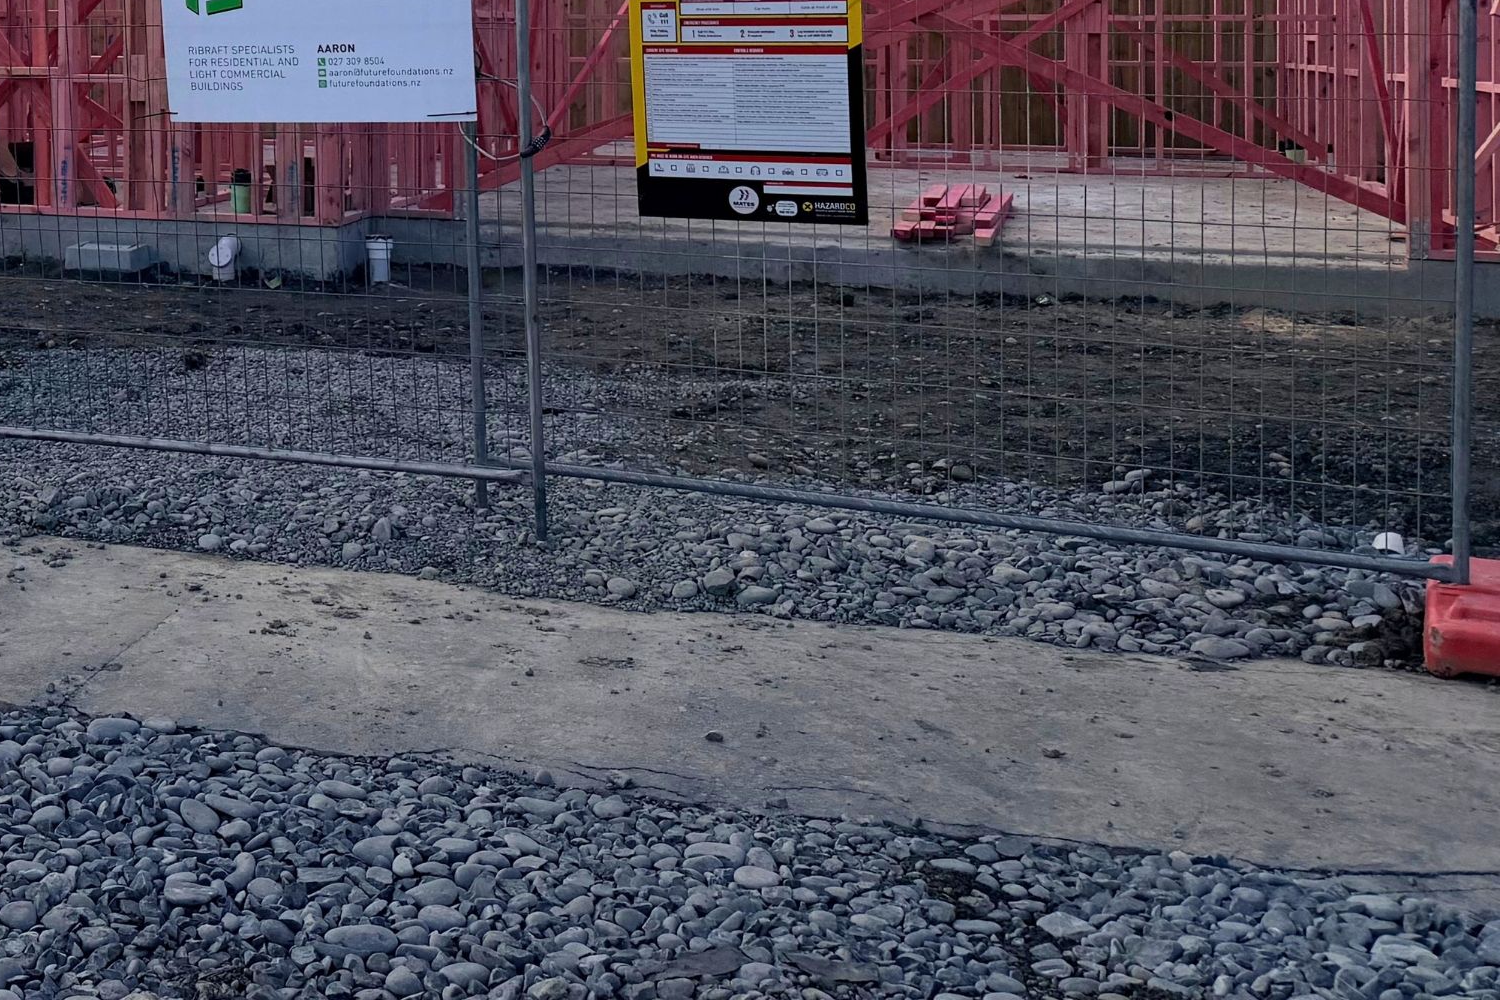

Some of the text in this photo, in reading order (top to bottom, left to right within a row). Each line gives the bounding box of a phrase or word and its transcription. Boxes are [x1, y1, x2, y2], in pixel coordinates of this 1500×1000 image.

[740, 29, 745, 39] 2
[789, 29, 794, 38] 3
[188, 44, 295, 55] RIBRAFT SPECIALISTS
[317, 43, 356, 54] AARON
[189, 56, 299, 67] FOR RESIDENTIAL AND
[328, 56, 385, 66] 027 309 8504
[189, 69, 286, 79] LIGHT COMMERCIAL
[328, 67, 454, 77] aaron@futurefoundations.nz
[190, 81, 244, 91] BUILDINGS
[329, 79, 421, 88] futurefoundations.nz
[814, 202, 856, 211] HAZARDCO
